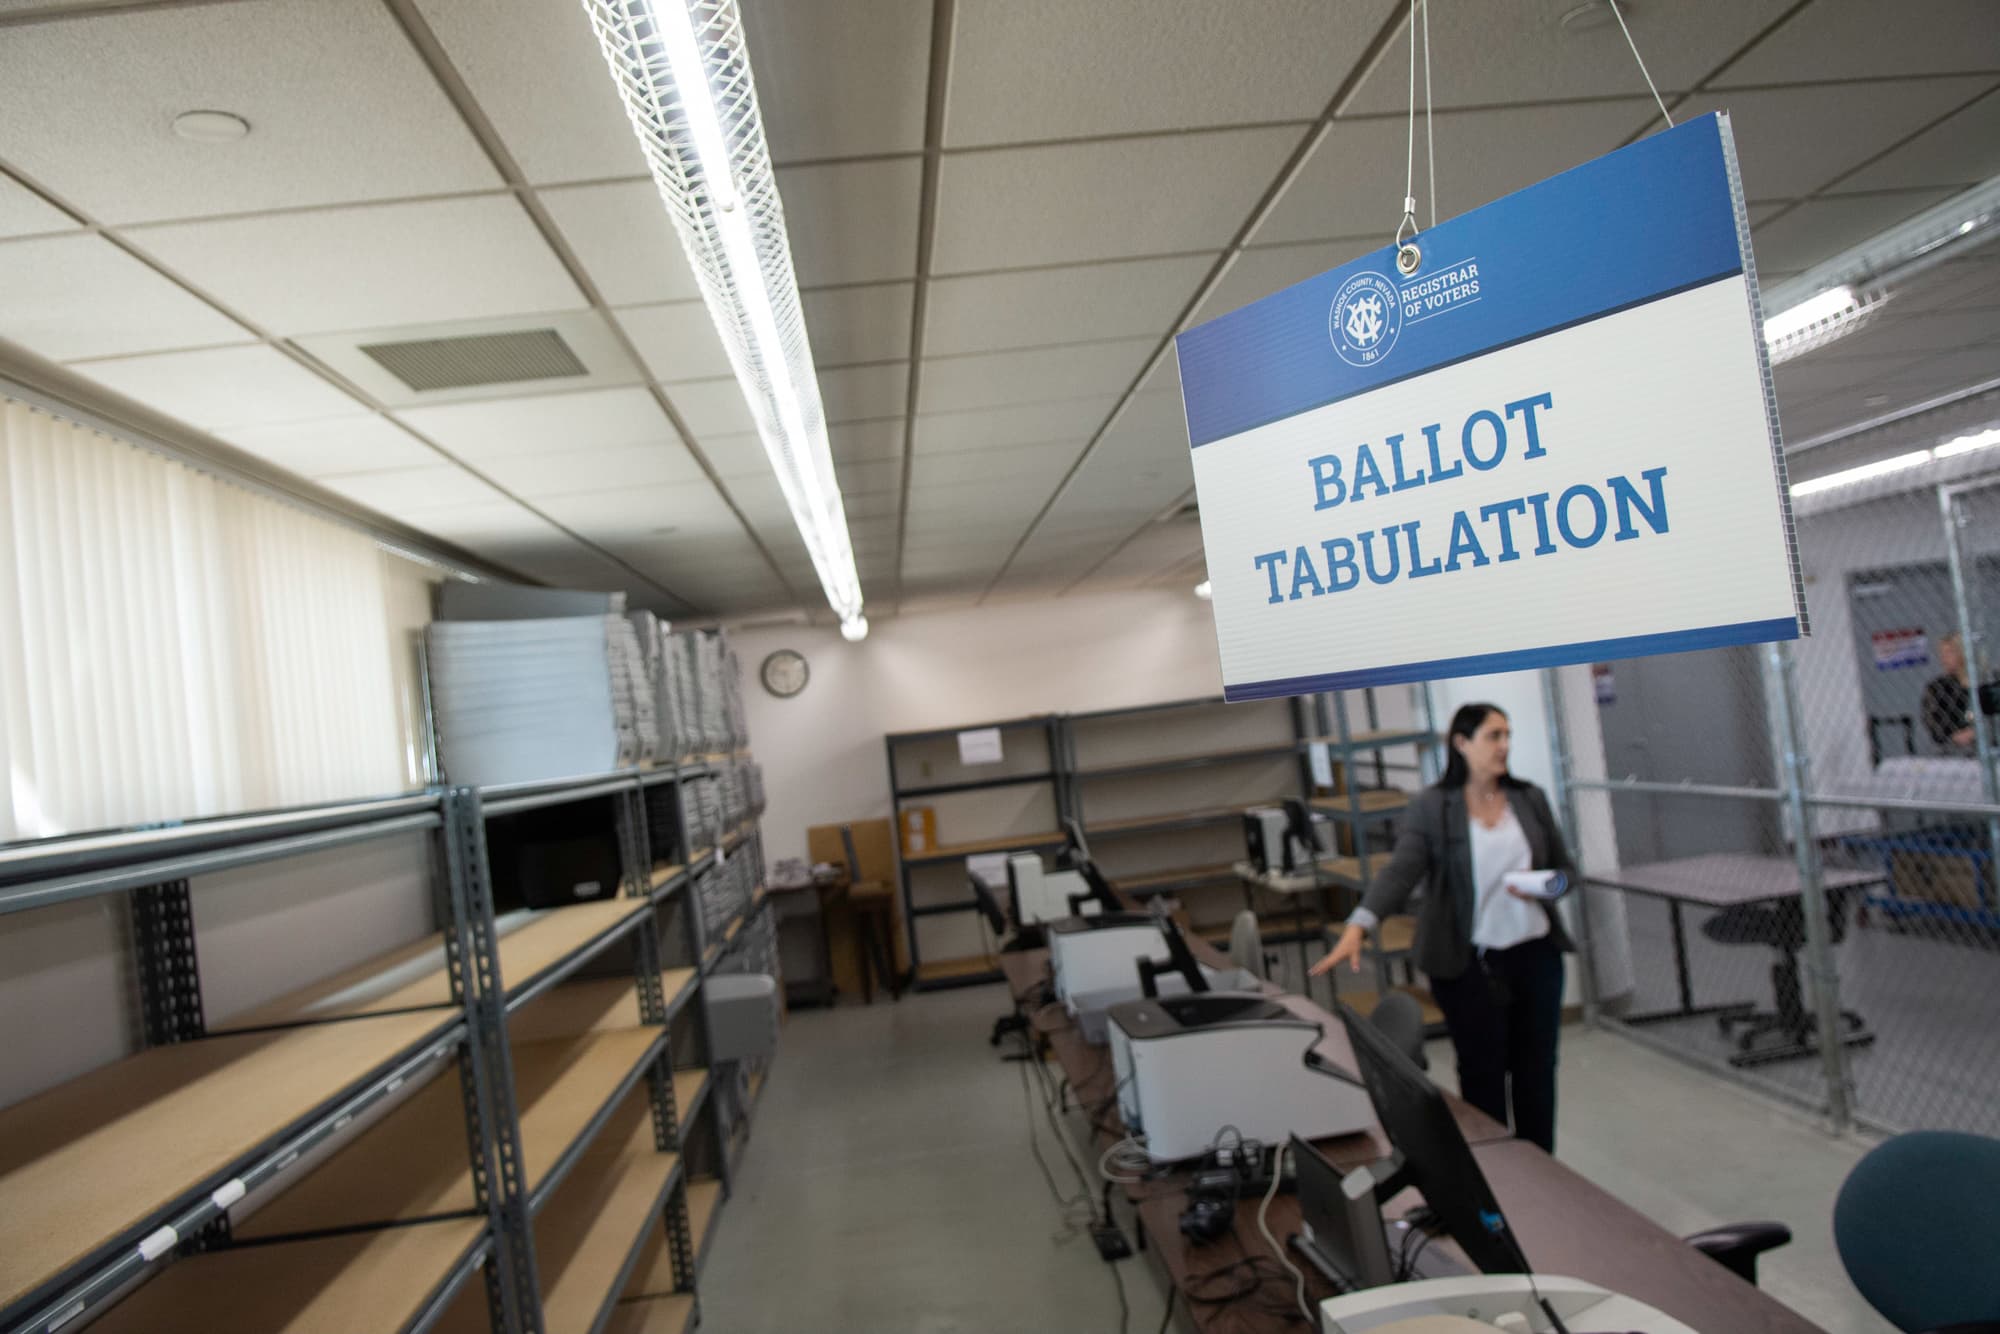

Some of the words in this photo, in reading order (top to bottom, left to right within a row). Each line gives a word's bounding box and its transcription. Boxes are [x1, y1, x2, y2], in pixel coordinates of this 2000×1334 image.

[1333, 292, 1347, 329] WASHOE
[1374, 280, 1396, 309] NEVADA
[1401, 264, 1479, 304] REGISTRAR
[1405, 301, 1422, 318] OF
[1424, 280, 1480, 310] VOTERS
[1362, 348, 1380, 361] 1861
[1307, 391, 1553, 512] BALLOT
[1254, 466, 1670, 605] TABULATION
